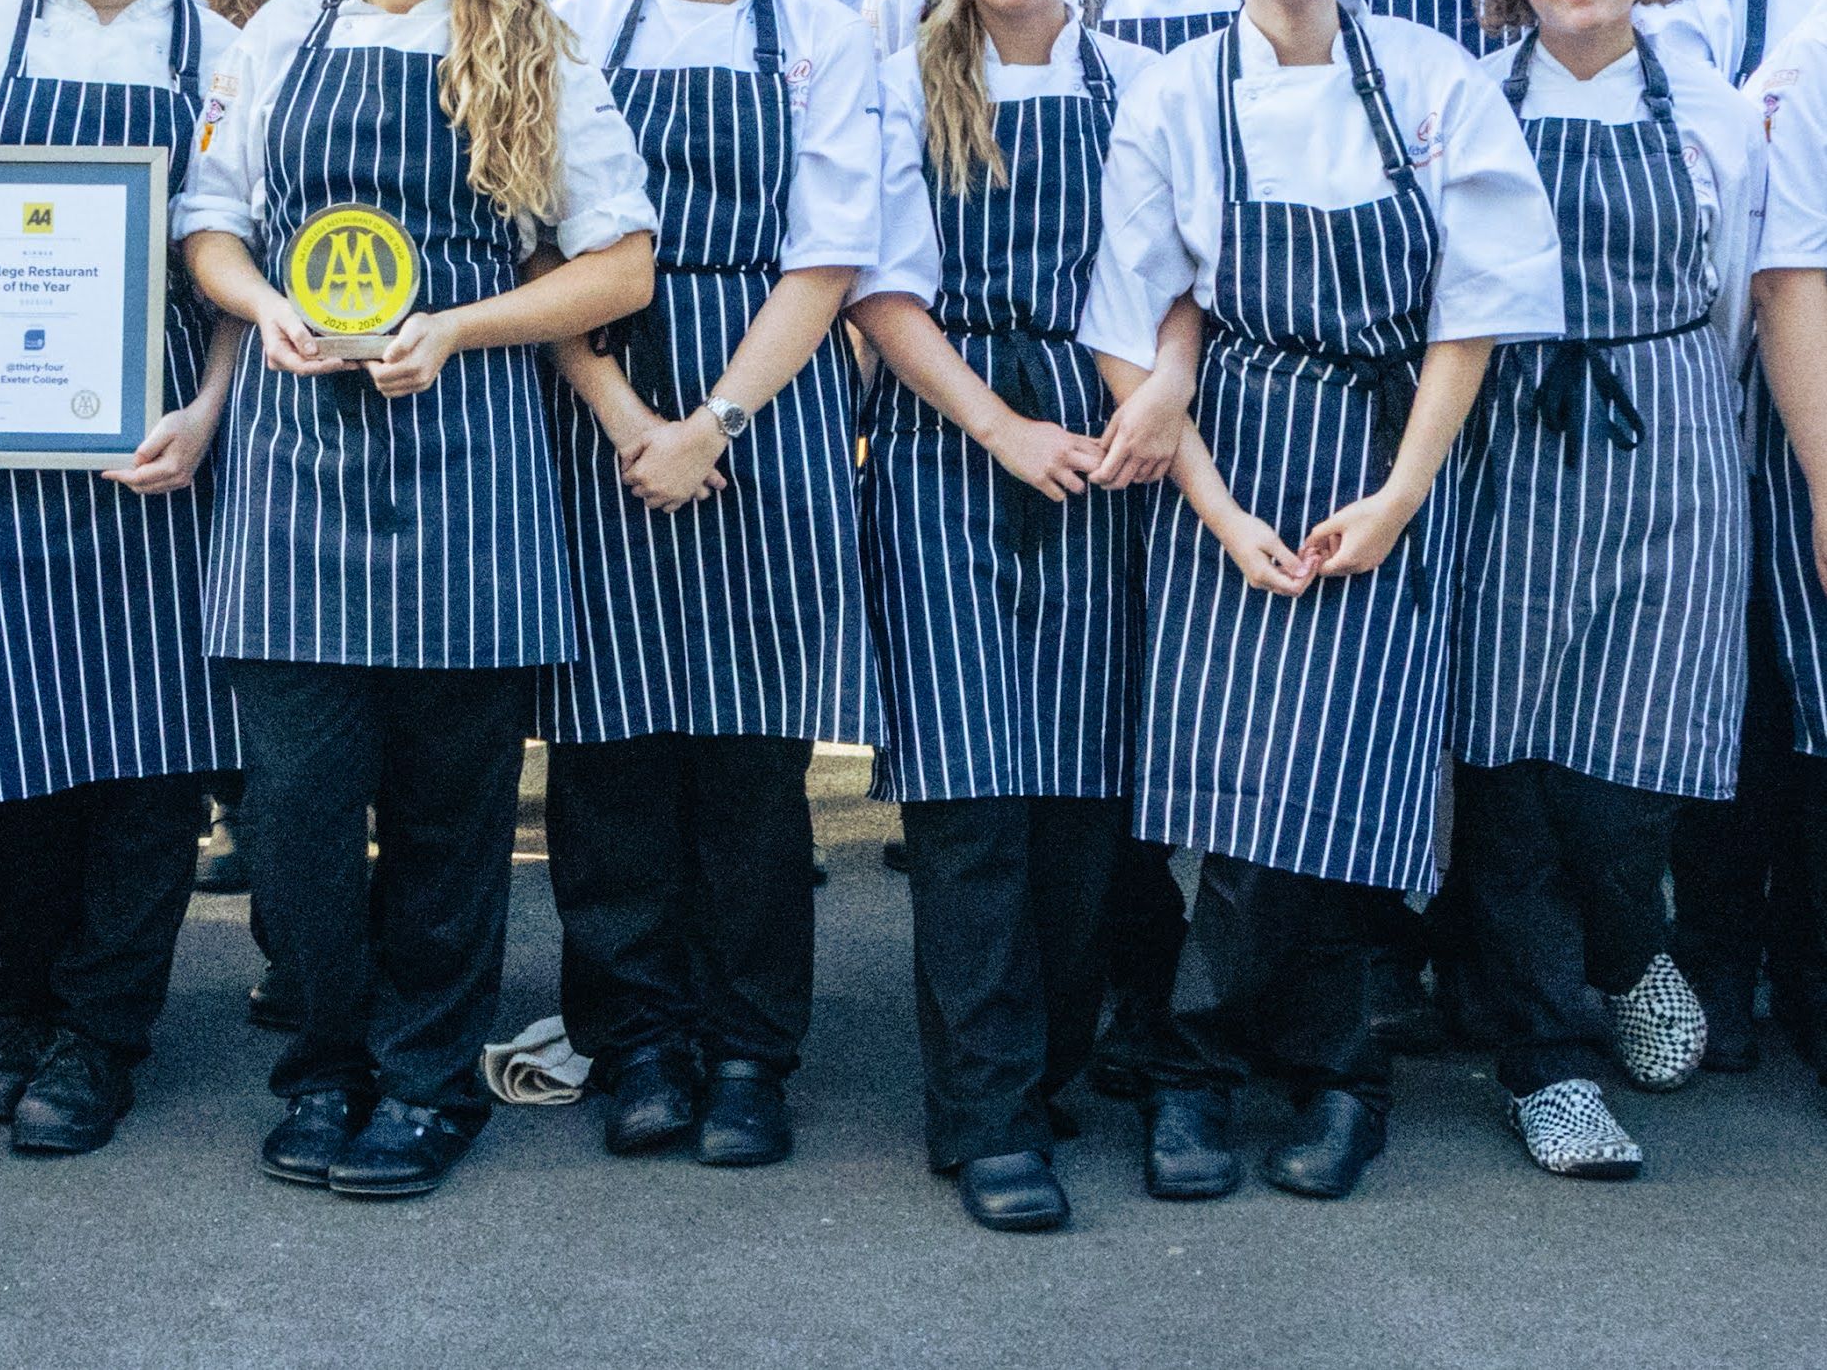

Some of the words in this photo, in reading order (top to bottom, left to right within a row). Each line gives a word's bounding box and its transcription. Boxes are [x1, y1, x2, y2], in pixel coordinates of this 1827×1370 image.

[26, 208, 52, 226] AA
[327, 217, 373, 227] RESTAURANT
[393, 241, 405, 261] YEAR
[28, 266, 99, 278] Restaurant
[3, 281, 16, 292] of
[19, 281, 40, 292] the
[42, 281, 71, 292] Year
[323, 316, 348, 331] 2025
[358, 316, 382, 331] 2026
[0, 375, 30, 384] Exeter
[32, 375, 69, 386] College
